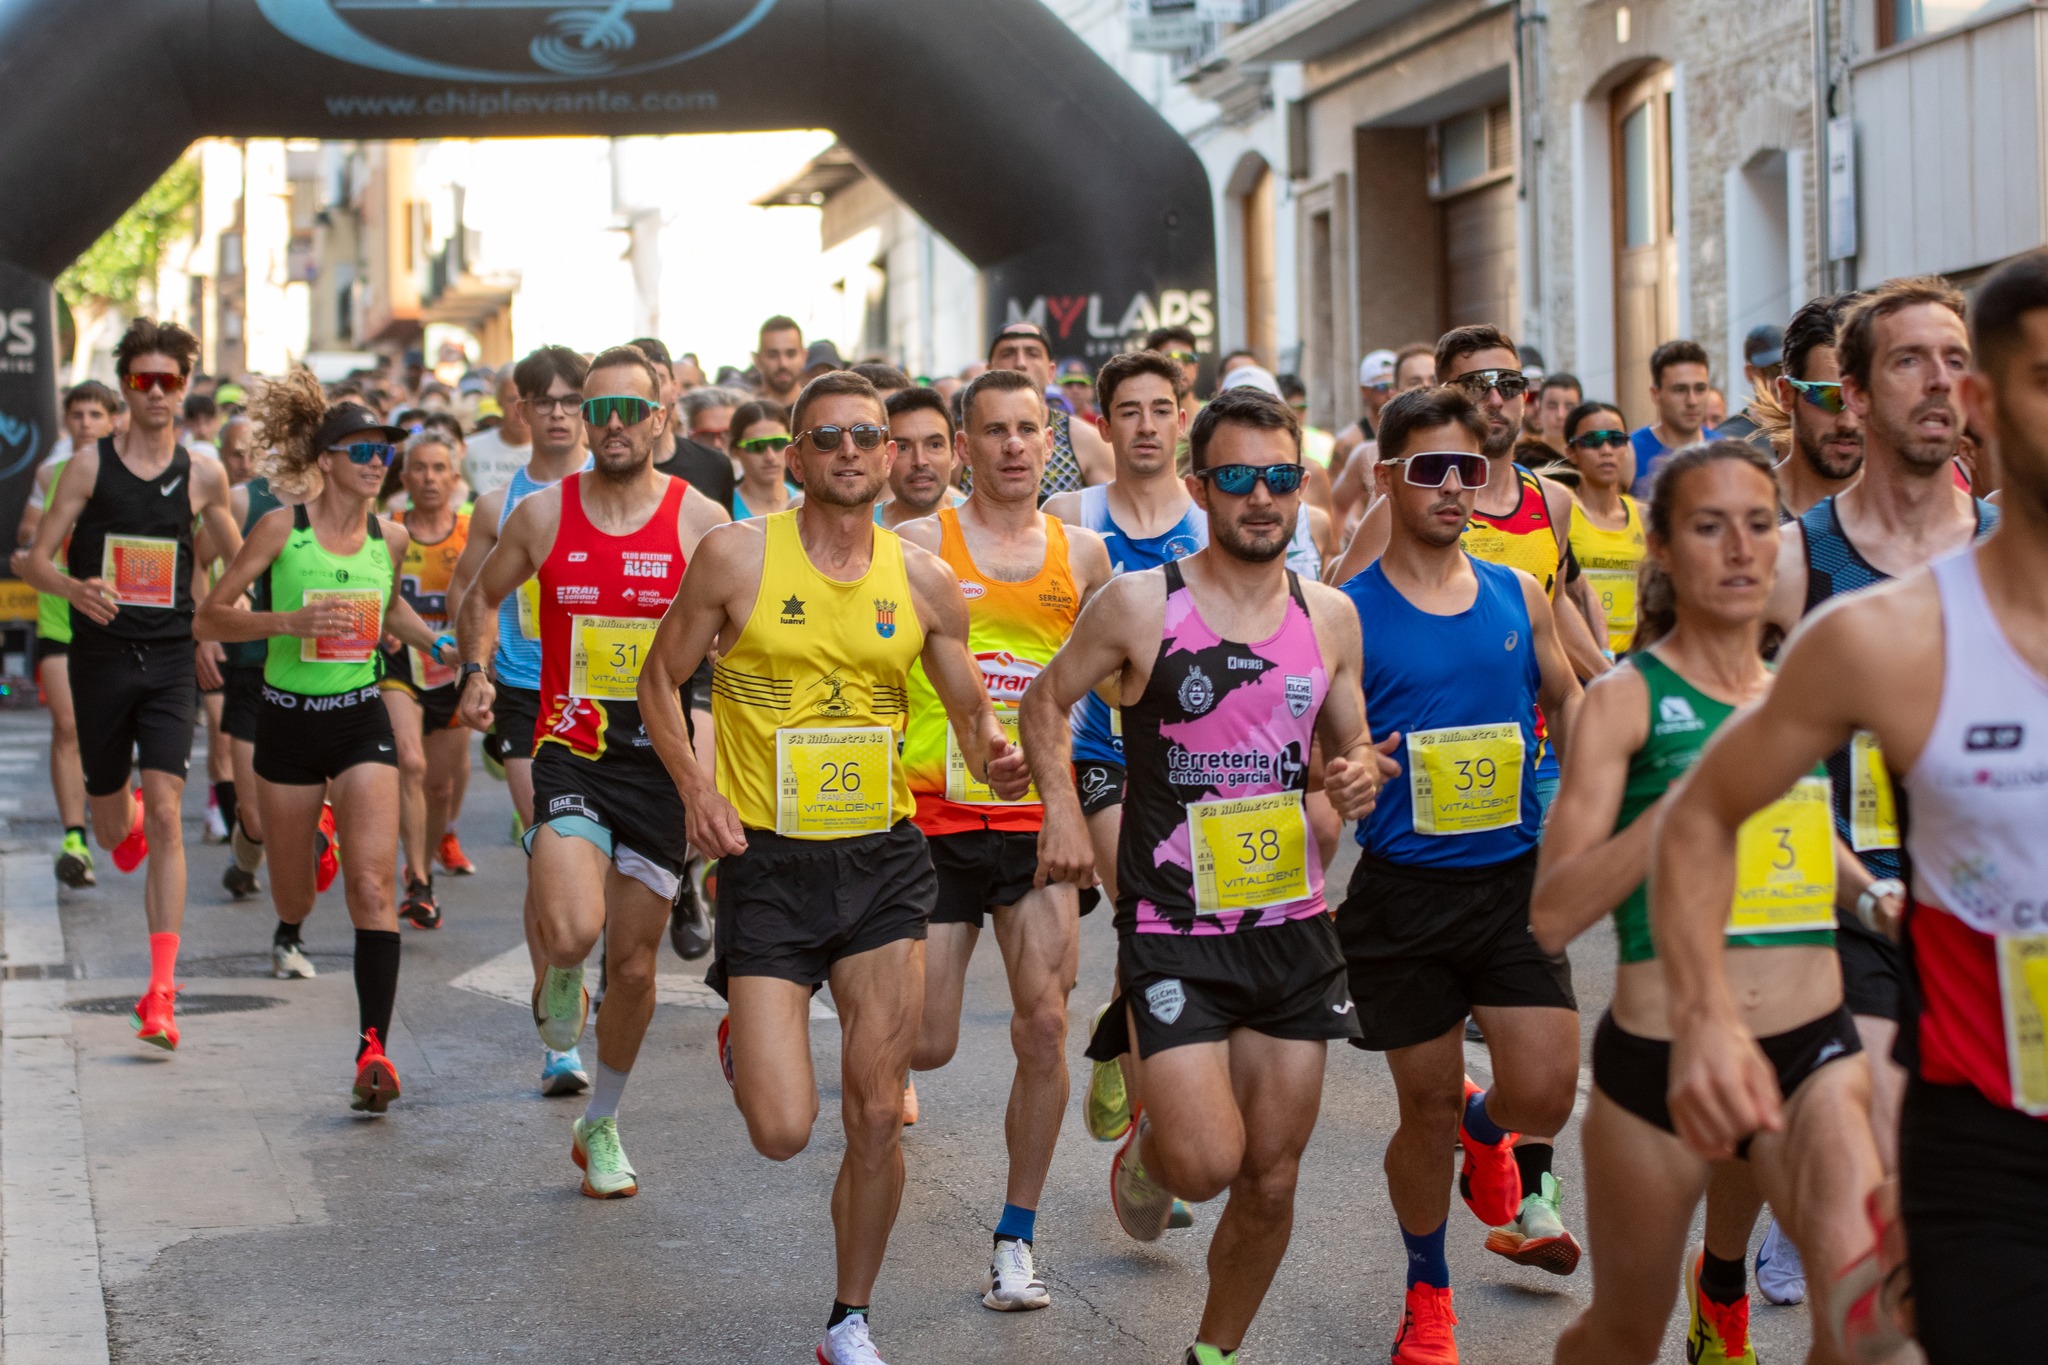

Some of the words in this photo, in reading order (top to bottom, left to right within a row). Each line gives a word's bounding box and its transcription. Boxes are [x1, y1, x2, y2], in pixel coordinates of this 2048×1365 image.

[326, 89, 717, 118] www.chiplevante.com
[1007, 288, 1214, 339] MYLAPS
[622, 552, 639, 560] CLUB
[130, 559, 160, 580] 116
[623, 560, 668, 578] ALCOI
[565, 586, 600, 595] TRAIL
[1038, 594, 1072, 604] SERRANO
[780, 617, 806, 625] luanvi
[609, 643, 638, 668] 31
[1287, 683, 1311, 694] ELCHE
[303, 692, 358, 712] NIKE
[1167, 746, 1271, 770] ferreteria
[820, 762, 861, 793] 26
[1168, 770, 1225, 786] antonio
[1228, 770, 1272, 788] garcia
[1454, 758, 1497, 791] 39
[816, 792, 865, 802] FRANCISCO
[1440, 795, 1516, 812] VITALDENT
[804, 802, 884, 813] VITALDENT
[1236, 829, 1280, 865] 38
[1772, 828, 1796, 870] 3
[1222, 867, 1302, 888] VITALDENT
[1244, 862, 1276, 874] MIGUEL
